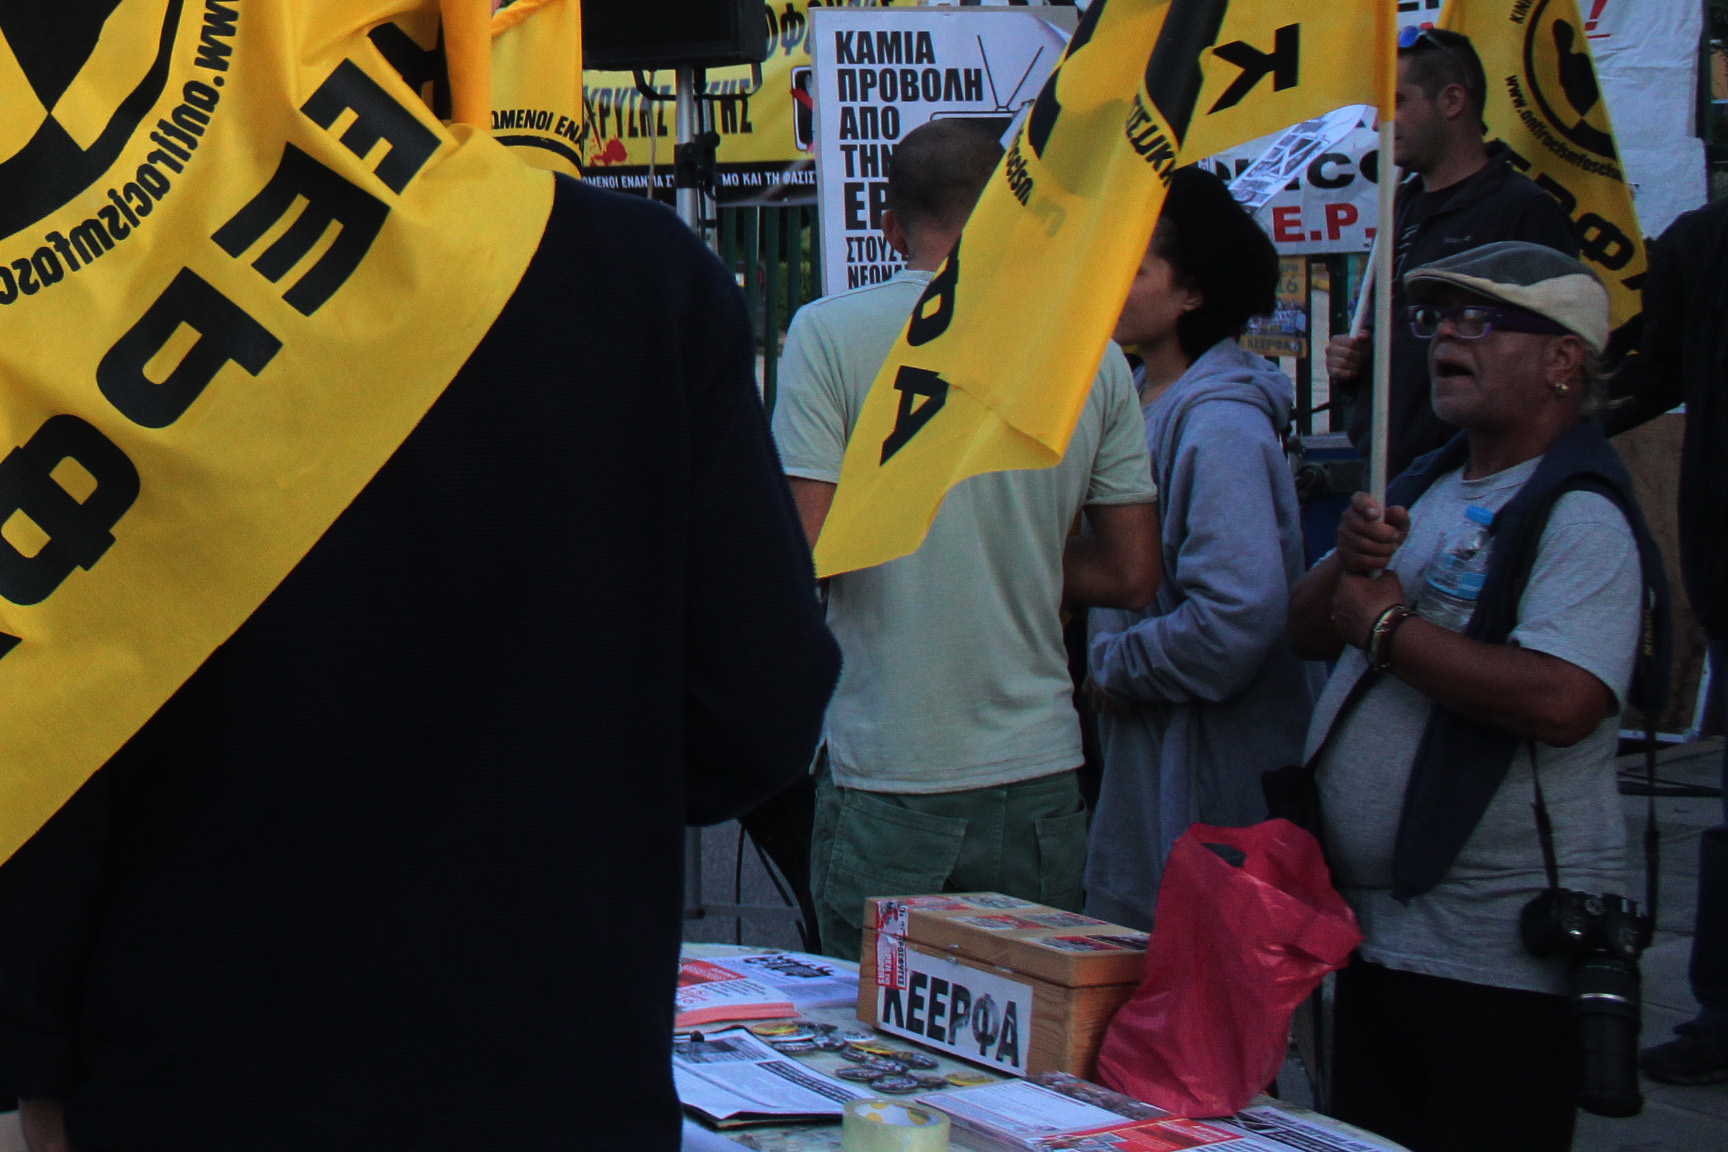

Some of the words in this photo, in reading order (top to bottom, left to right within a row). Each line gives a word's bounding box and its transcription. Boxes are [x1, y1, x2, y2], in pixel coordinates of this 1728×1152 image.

[834, 30, 936, 64] ΚΑΜΙΑ
[836, 67, 984, 102] ΠΡΟΒΟΛΗ
[490, 108, 555, 133] ΩΜΕΝΟΙ
[839, 106, 901, 140] ΑΠΟ
[621, 174, 664, 189] ΕΝΑΝΙΑ
[782, 169, 817, 185] ΦΑΣΙΣ
[843, 182, 890, 230] ΕΡ
[1272, 203, 1377, 243] Ε.Ρ.
